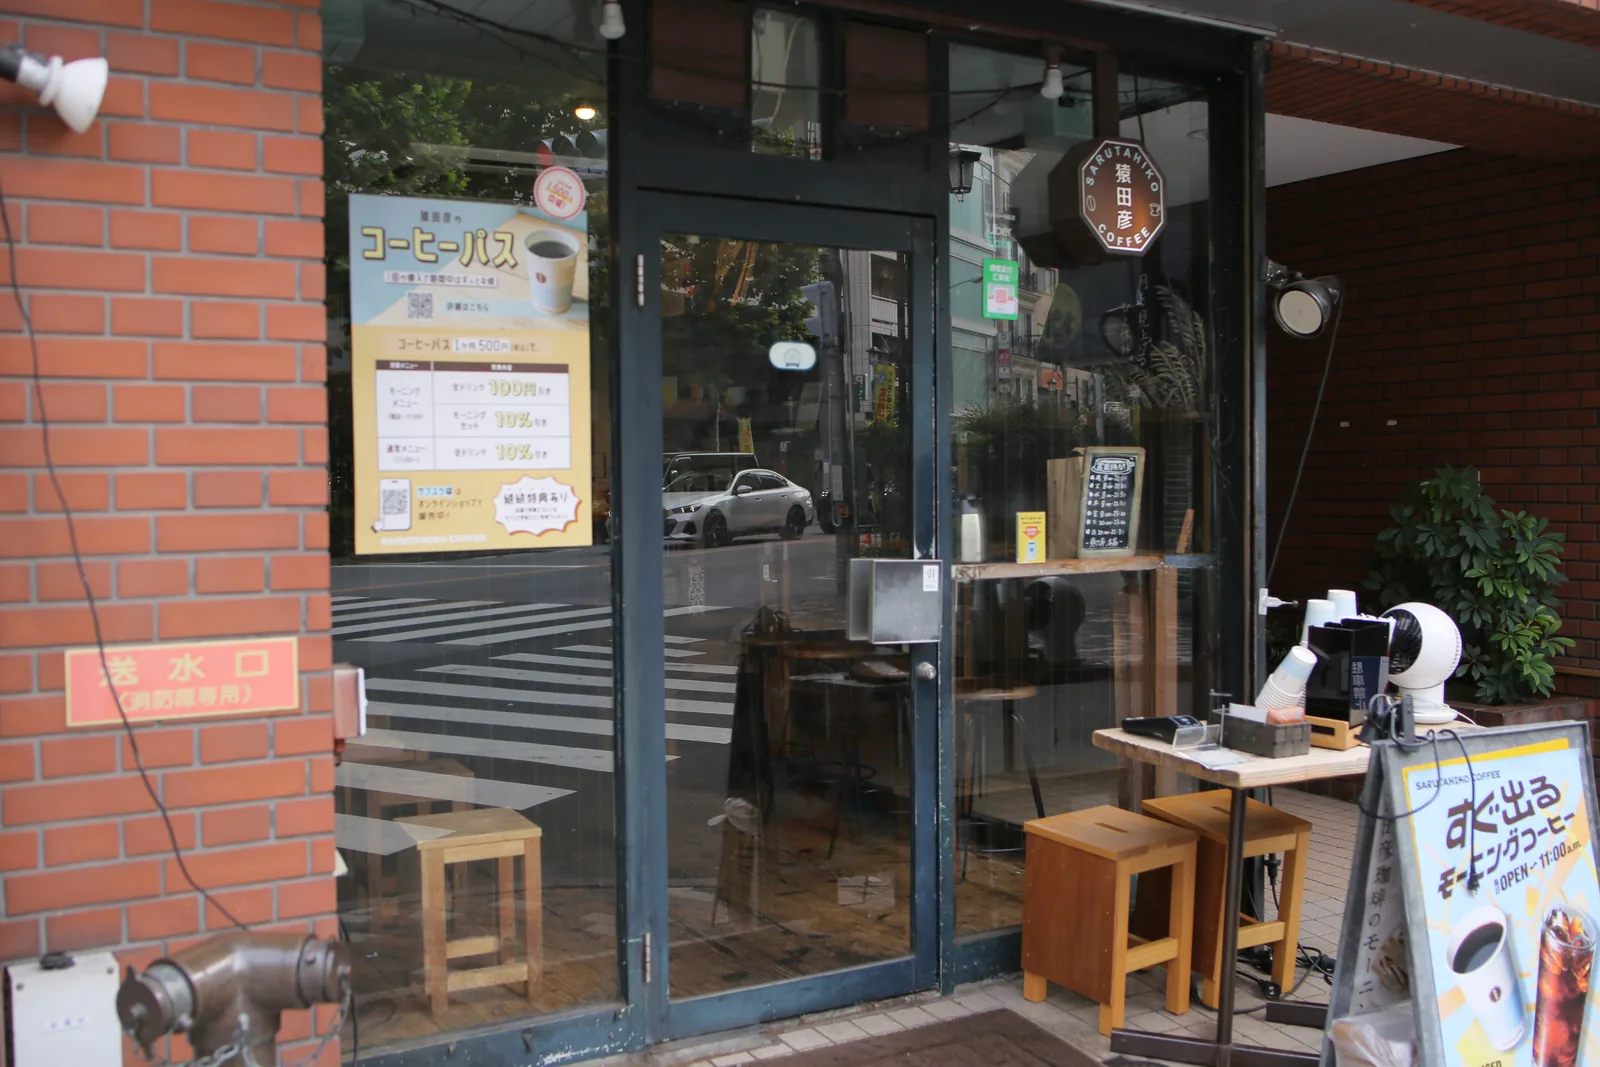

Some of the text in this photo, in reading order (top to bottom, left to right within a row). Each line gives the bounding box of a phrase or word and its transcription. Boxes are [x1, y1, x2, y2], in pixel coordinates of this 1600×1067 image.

[1086, 146, 1159, 192] SARUTAHIKO
[1115, 163, 1133, 230] 猿田彦
[361, 224, 518, 270] コーヒーパス
[1099, 224, 1150, 247] COFFEE
[398, 338, 450, 350] コーヒーパス
[488, 380, 536, 396] 100円
[495, 411, 532, 428] 10%
[496, 444, 533, 461] 10%
[98, 649, 269, 687] 送水口
[1446, 775, 1562, 849] すぐ出る
[1438, 812, 1576, 900] モーニングコーヒー
[1500, 863, 1528, 892] OPEN
[1540, 841, 1567, 868] 11:00
[1567, 840, 1582, 854] a.m.
